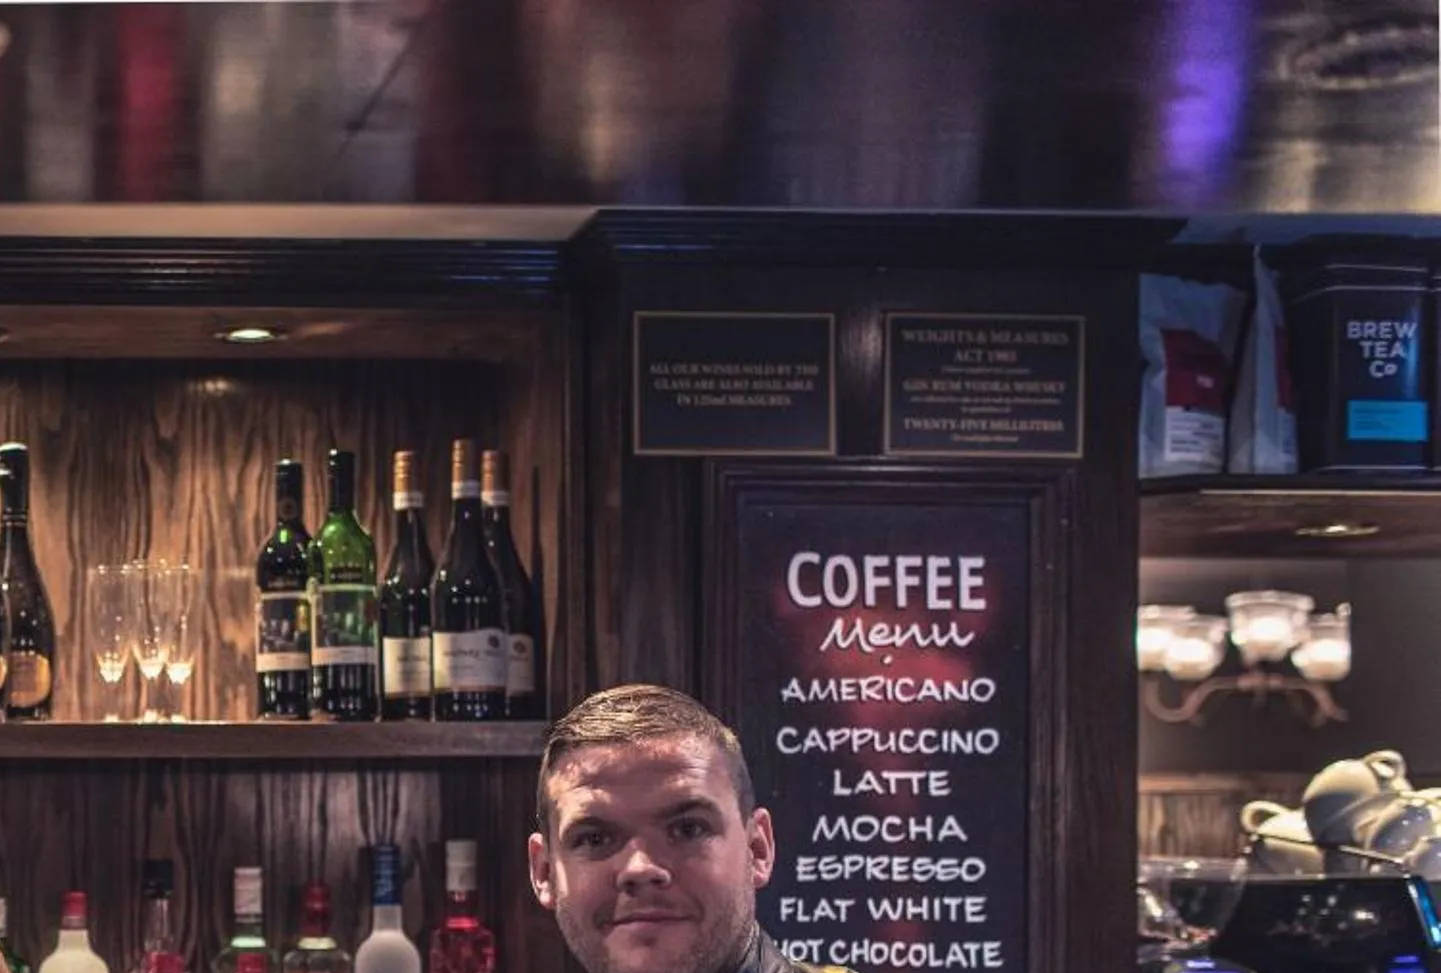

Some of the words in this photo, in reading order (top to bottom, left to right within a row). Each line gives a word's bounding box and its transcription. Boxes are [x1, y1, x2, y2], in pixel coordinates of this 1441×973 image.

[1347, 321, 1417, 339] BREW
[1359, 340, 1408, 358] TEA
[786, 552, 987, 611] COFFEE
[820, 617, 974, 652] Menu
[781, 676, 996, 703] AMERICANO
[776, 726, 1000, 755] CAPPUCCINO
[832, 769, 951, 796] LATTE
[812, 815, 968, 843] MOCHA
[795, 856, 986, 883] ESPRESSO
[779, 897, 856, 923] FLAT
[867, 897, 988, 923] WHITE
[828, 939, 1004, 969] CHOCOLATE
